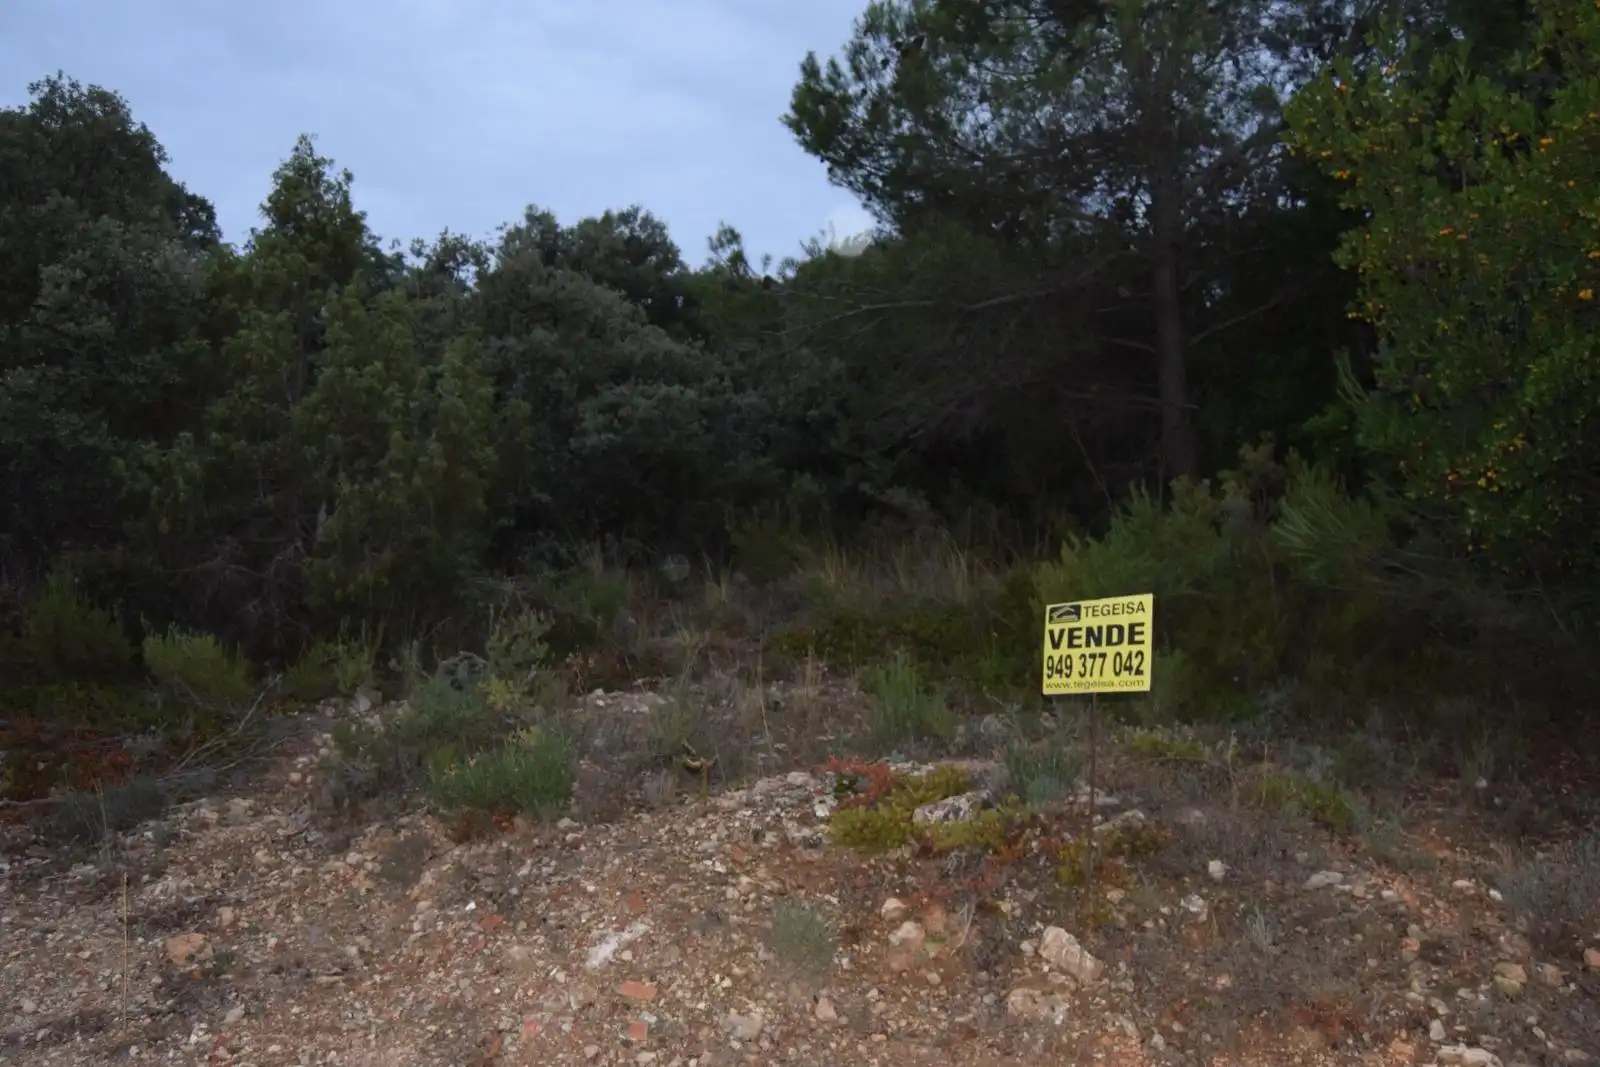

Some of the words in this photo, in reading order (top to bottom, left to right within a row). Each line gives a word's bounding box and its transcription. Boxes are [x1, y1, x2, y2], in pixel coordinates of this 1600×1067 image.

[1084, 601, 1145, 617] TEGEISA
[1048, 622, 1145, 650] VENDE
[1046, 654, 1073, 679] 949
[1079, 652, 1107, 677] 377
[1113, 650, 1144, 677] 042
[1046, 680, 1144, 690] www.tegeisa.com
